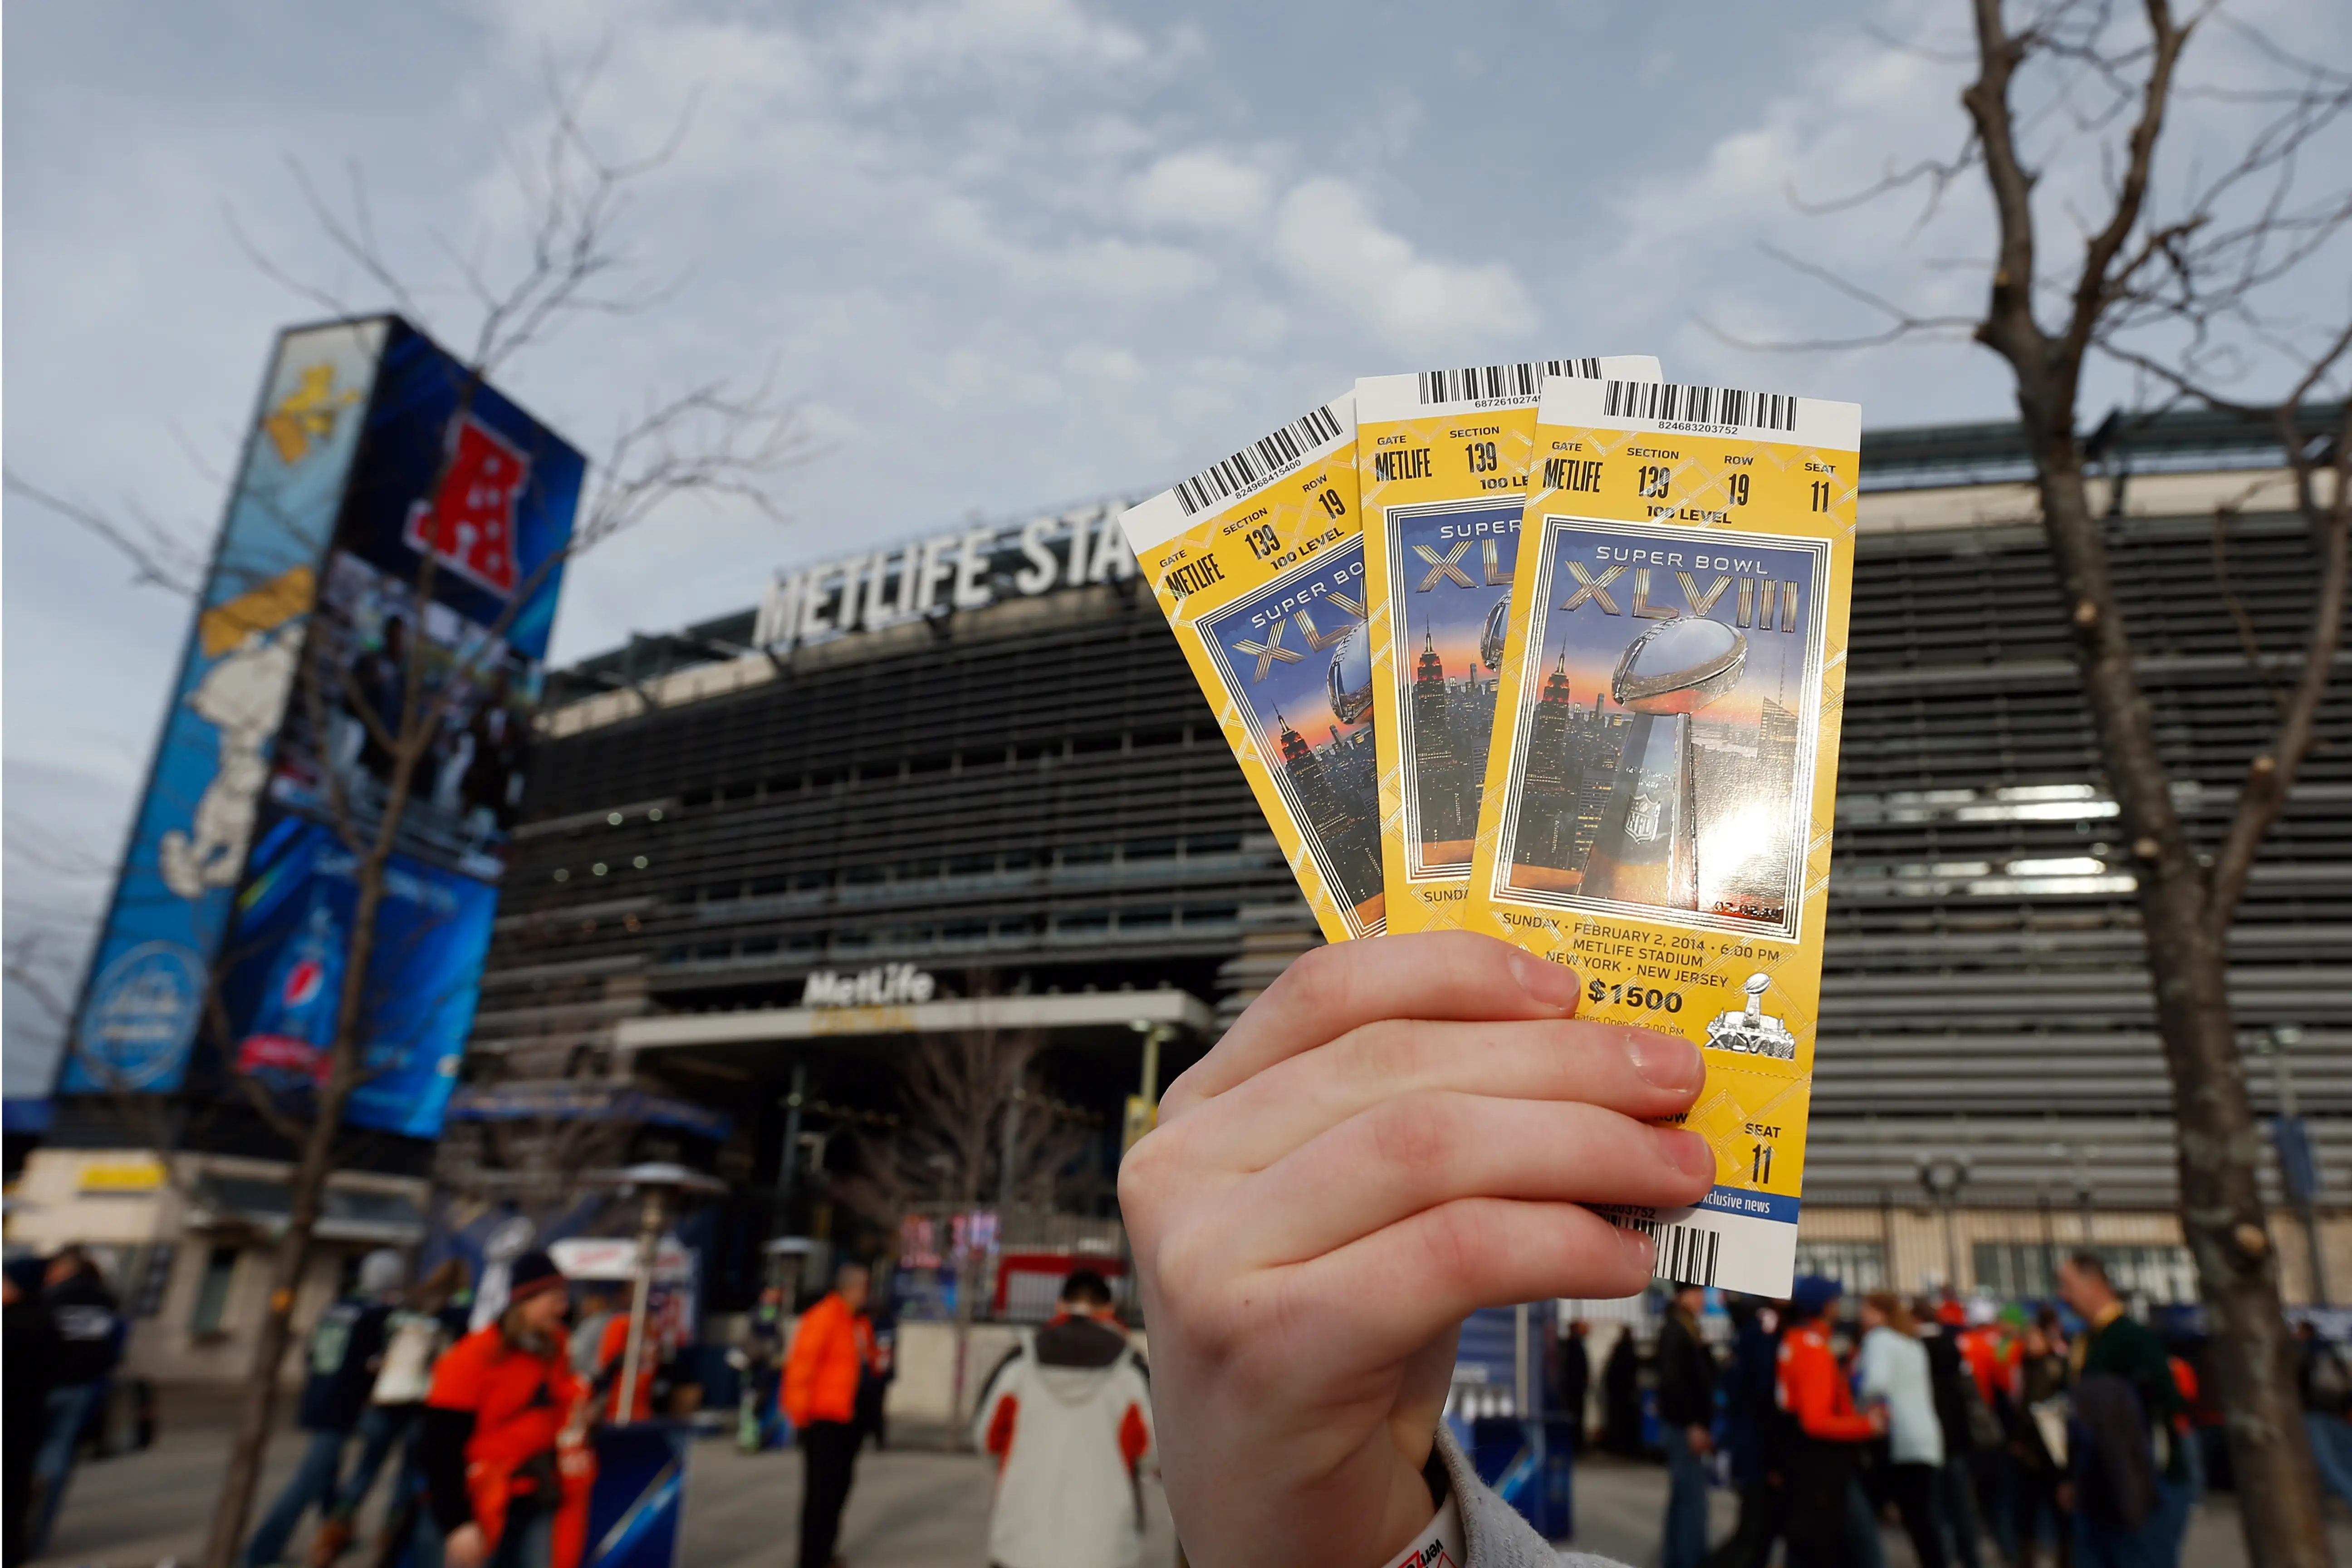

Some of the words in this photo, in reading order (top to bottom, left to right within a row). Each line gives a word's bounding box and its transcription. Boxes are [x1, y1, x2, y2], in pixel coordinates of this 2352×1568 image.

[1377, 436, 1406, 445] GATE
[1450, 426, 1499, 438] SECTION
[1658, 421, 1738, 434] 824683203752
[1375, 448, 1432, 481] METLIFE
[1465, 442, 1497, 473] 139
[1552, 441, 1582, 452] GATE
[1627, 447, 1679, 459] SECTION
[1725, 456, 1754, 466] ROW
[1804, 462, 1836, 474] SEAT
[1235, 460, 1301, 499] 824968415400
[1480, 478, 1508, 490] 100
[1543, 458, 1603, 493] METLIFE
[1638, 466, 1670, 499] 139
[1729, 473, 1749, 506] 19
[1811, 481, 1829, 512] 11
[1223, 508, 1268, 535] SECTION
[1303, 474, 1327, 492] ROW
[1646, 505, 1674, 519] 100
[1680, 509, 1732, 524] LEVEL
[1245, 524, 1280, 559] 139
[1319, 489, 1346, 519] 19
[1441, 520, 1522, 539] SUPER
[1160, 550, 1187, 568] GATE
[1271, 552, 1297, 570] 100
[1298, 528, 1344, 556] LEVEL
[1596, 546, 1683, 567] SUPER
[1695, 555, 1769, 575] BOWL
[753, 529, 995, 646] METLIFE
[1166, 553, 1225, 601] METLIFE
[1252, 582, 1327, 628] SUPER
[1558, 560, 1798, 633] XLVIII
[1503, 913, 1560, 929] SUNDAY
[1574, 922, 1650, 943] FEBRUARY
[1654, 935, 1666, 947] 2,
[1671, 937, 1705, 950] 2014
[1720, 944, 1752, 958] 6:00
[1758, 949, 1779, 961] PM
[1573, 939, 1634, 957] METLIFE
[1638, 948, 1702, 967] STADIUM
[802, 962, 935, 1007] MetLife
[1546, 951, 1578, 965] NEW
[1584, 956, 1621, 972] YORK
[1637, 965, 1671, 979] NEW
[1674, 970, 1729, 988] JERSEY
[1588, 978, 1682, 1014] $1500
[1745, 1123, 1781, 1138] SEAT
[1753, 1144, 1771, 1184] 11
[1701, 1192, 1741, 1210] xclusive
[1744, 1200, 1770, 1214] news
